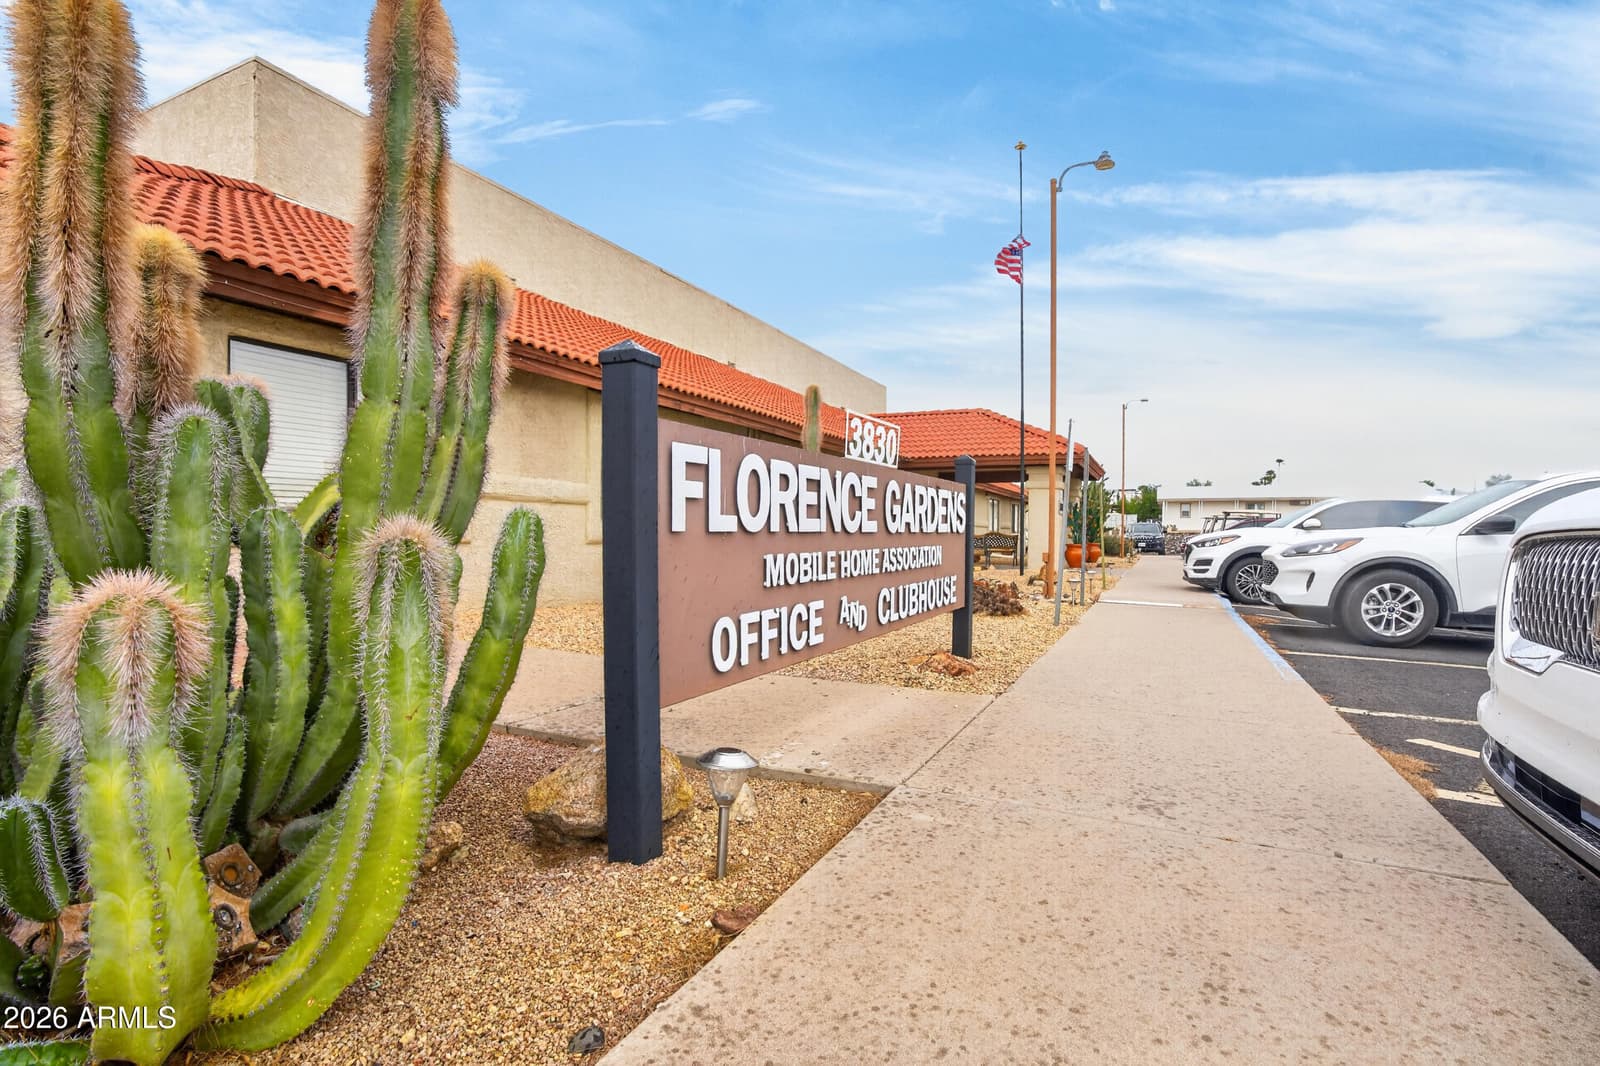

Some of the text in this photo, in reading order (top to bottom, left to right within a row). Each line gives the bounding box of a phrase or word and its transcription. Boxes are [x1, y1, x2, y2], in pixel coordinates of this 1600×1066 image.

[849, 417, 898, 465] 3830
[671, 441, 967, 534] FLORENCE GARDENS
[763, 545, 943, 587] MOBILE HOME ASSOCIATION
[712, 576, 958, 673] OFFICE AND CLUBHOUSE
